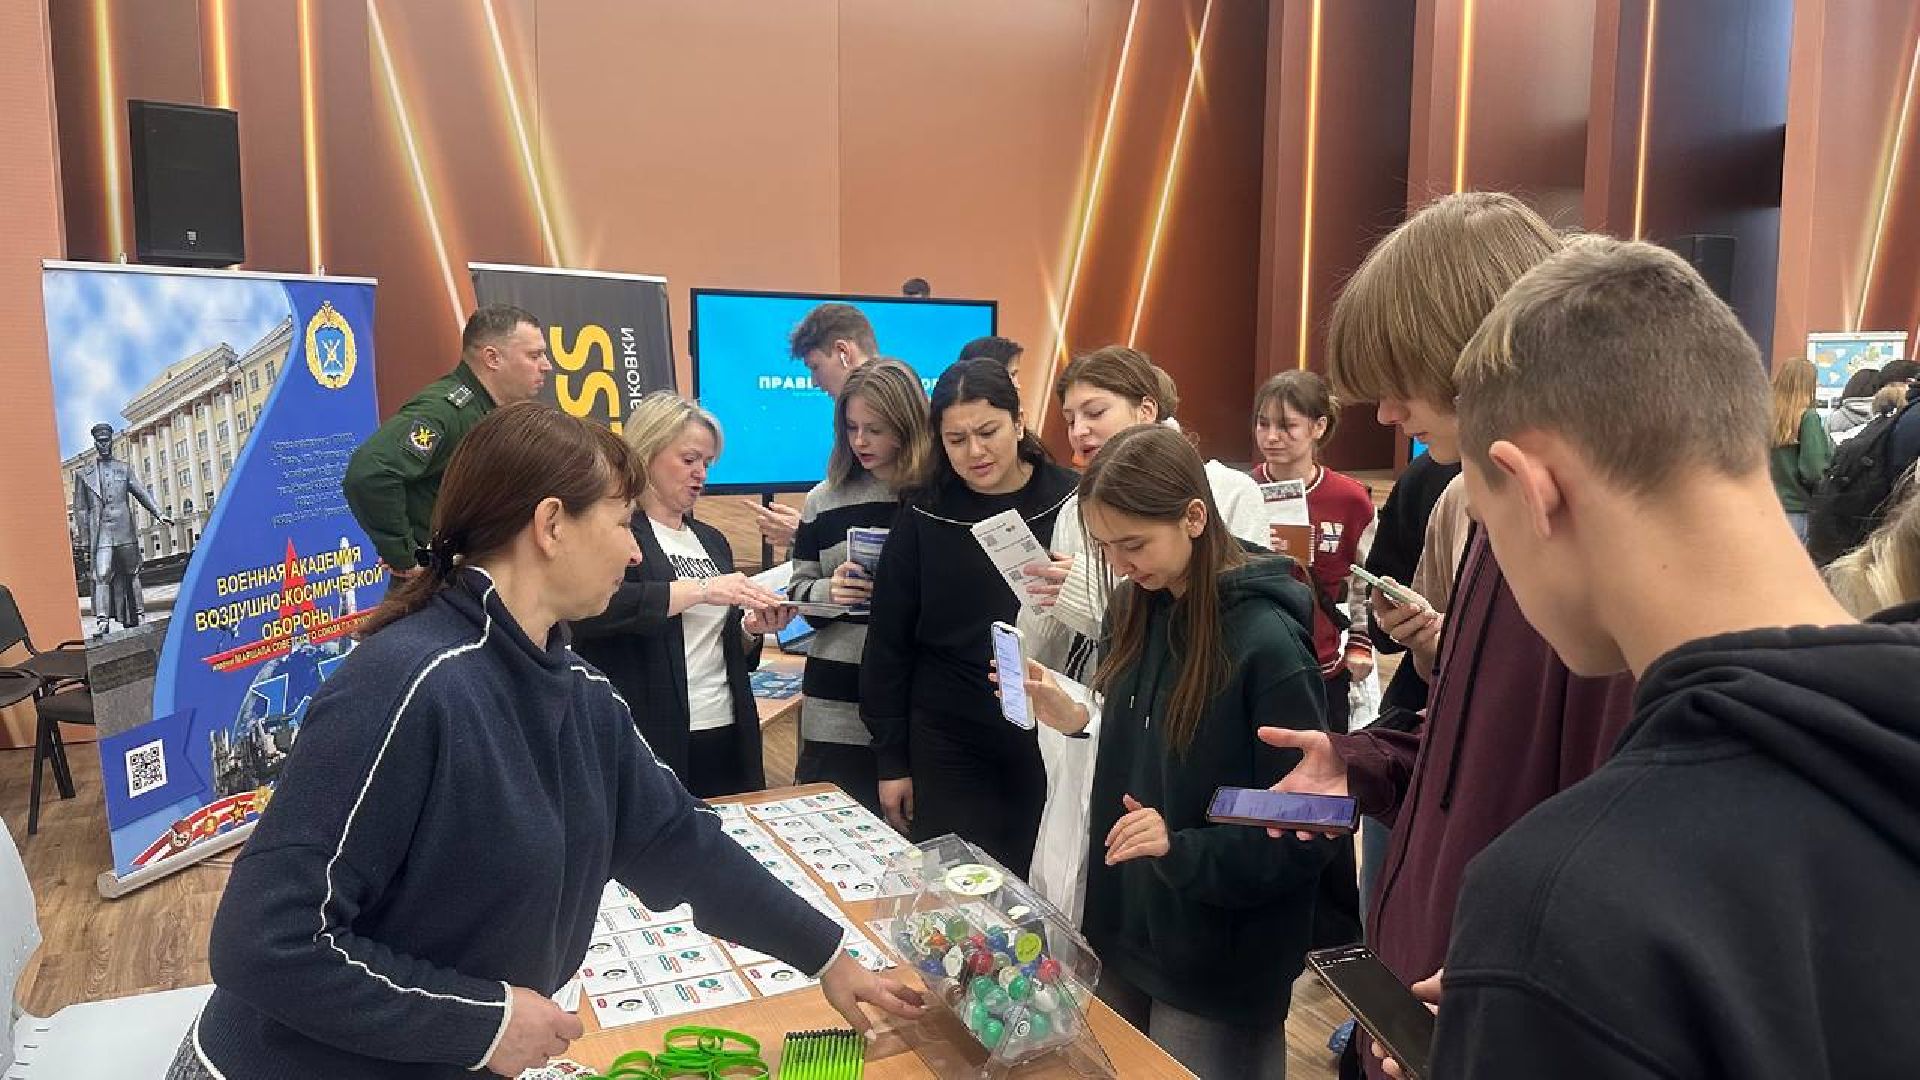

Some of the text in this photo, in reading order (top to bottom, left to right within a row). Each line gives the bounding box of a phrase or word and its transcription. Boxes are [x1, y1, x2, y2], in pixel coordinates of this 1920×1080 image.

[550, 325, 622, 436] SS
[621, 327, 643, 411] аковки
[195, 564, 384, 632] ВОЗДУШНО-КОСМИЧЕСКОЙ
[216, 546, 362, 596] ВОЕННАЯ АКАДЕМИЯ
[261, 605, 334, 640] ОБОРОНЫ
